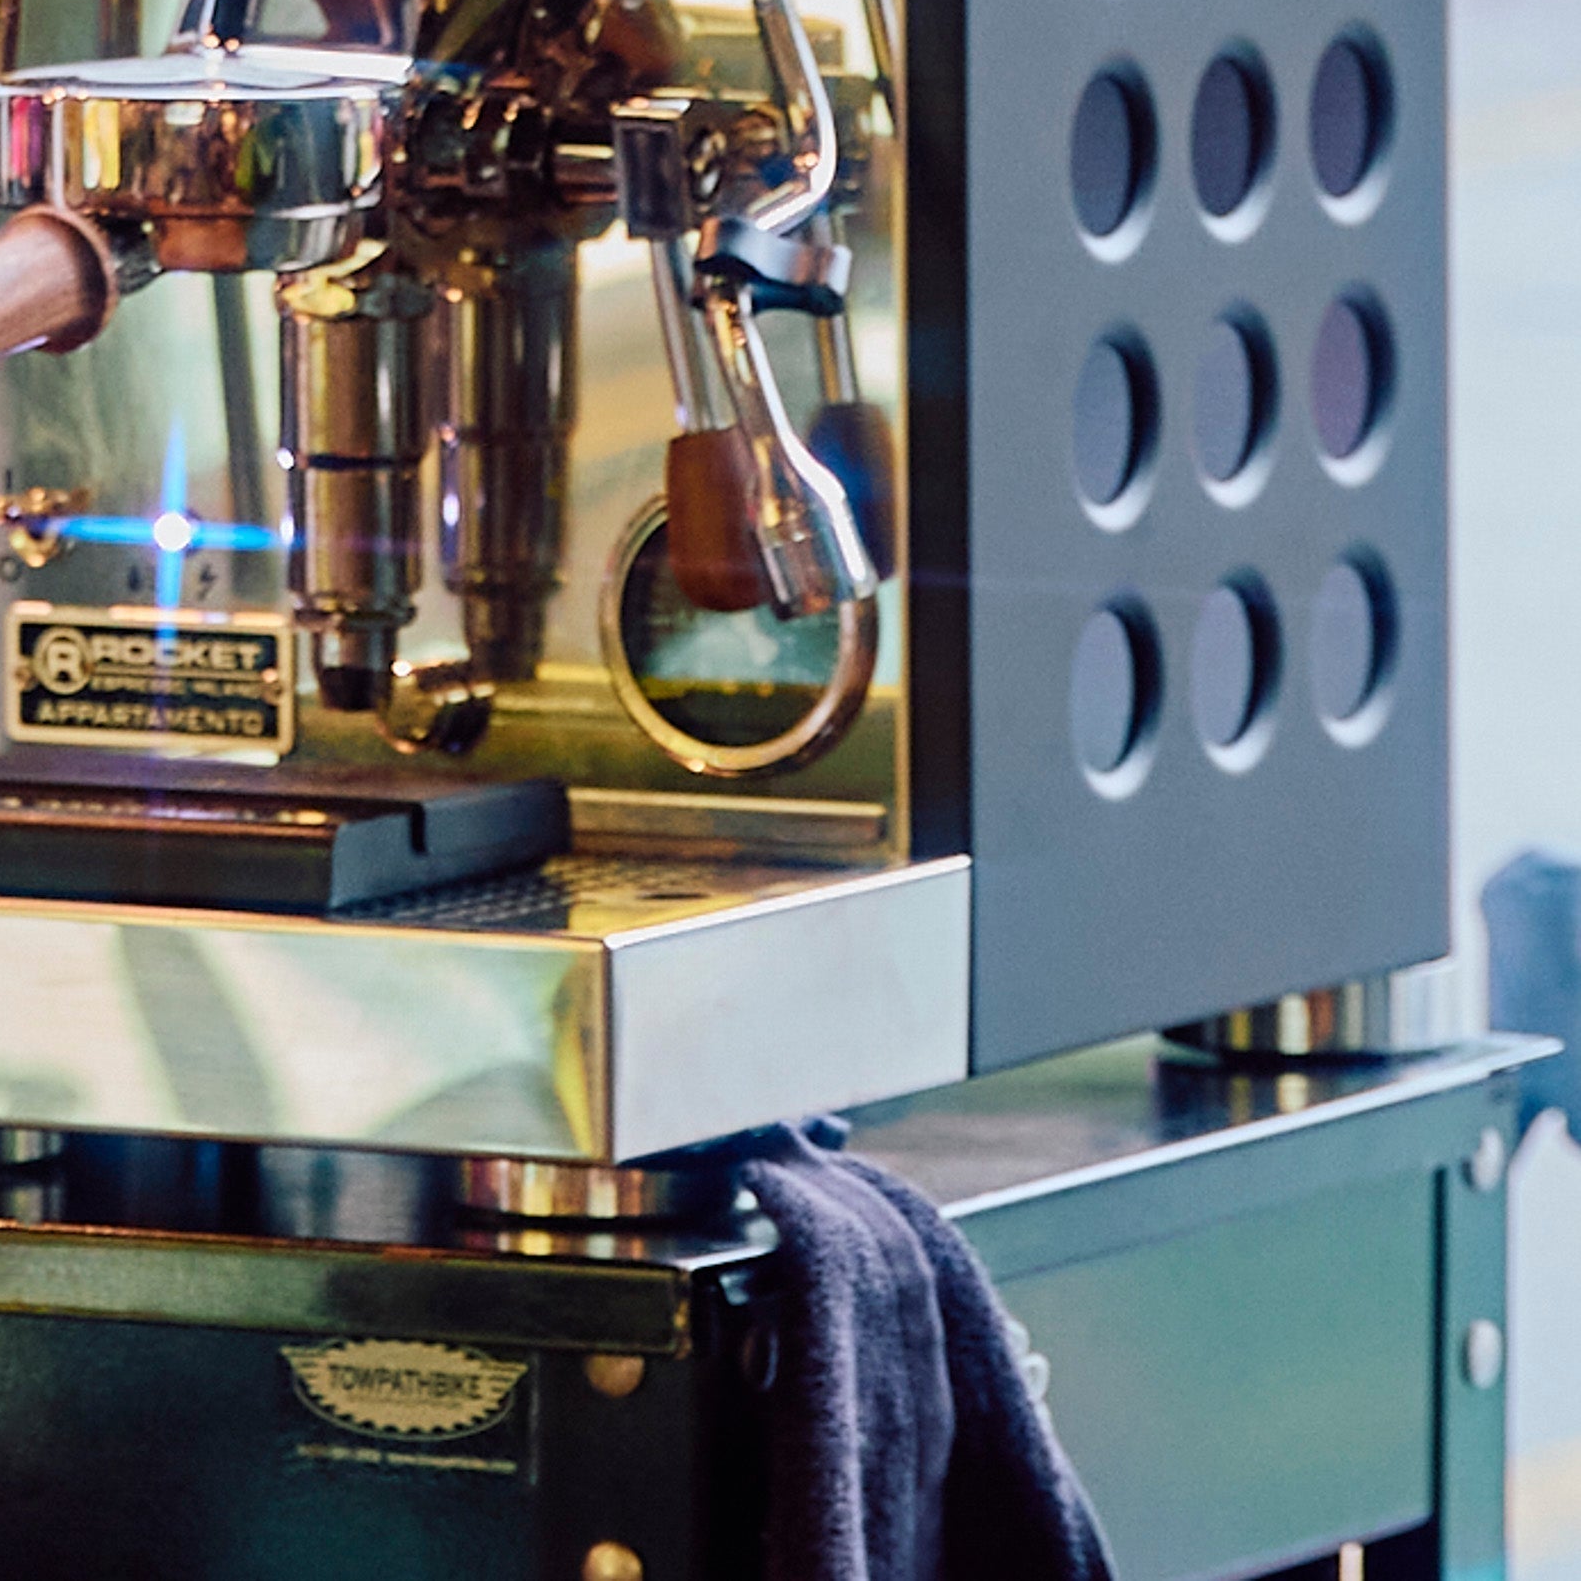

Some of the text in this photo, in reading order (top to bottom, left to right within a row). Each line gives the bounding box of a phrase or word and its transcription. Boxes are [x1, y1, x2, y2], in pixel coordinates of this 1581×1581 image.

[91, 633, 263, 671] ROCKET
[37, 700, 265, 735] APPARTAMENTO
[328, 1363, 483, 1401] TOWPATHBIKE
